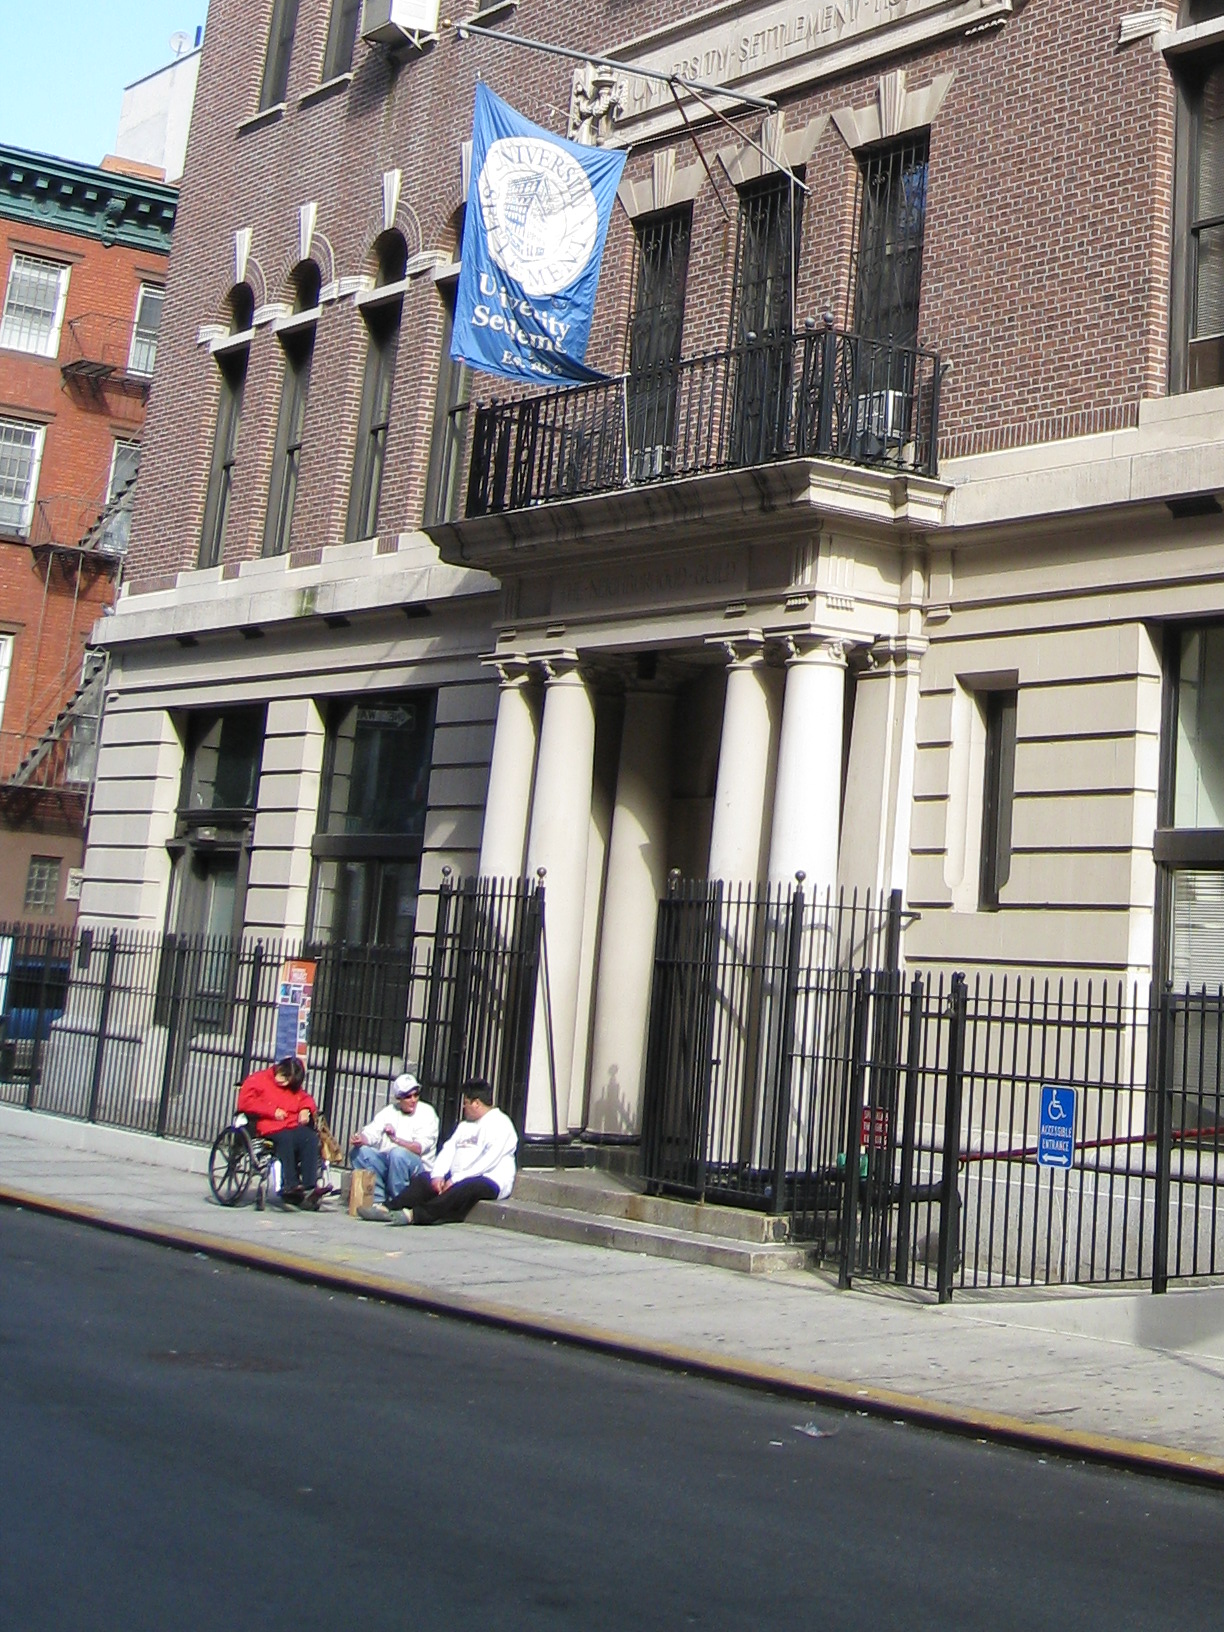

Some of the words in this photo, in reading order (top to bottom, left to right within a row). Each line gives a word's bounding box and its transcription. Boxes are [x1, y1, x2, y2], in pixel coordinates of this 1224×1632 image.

[633, 45, 730, 102] UNERSITY
[479, 272, 570, 342] Uiveity
[1041, 1124, 1072, 1138] ACCESSIBLE
[1042, 1139, 1069, 1151] ENTRANCE
